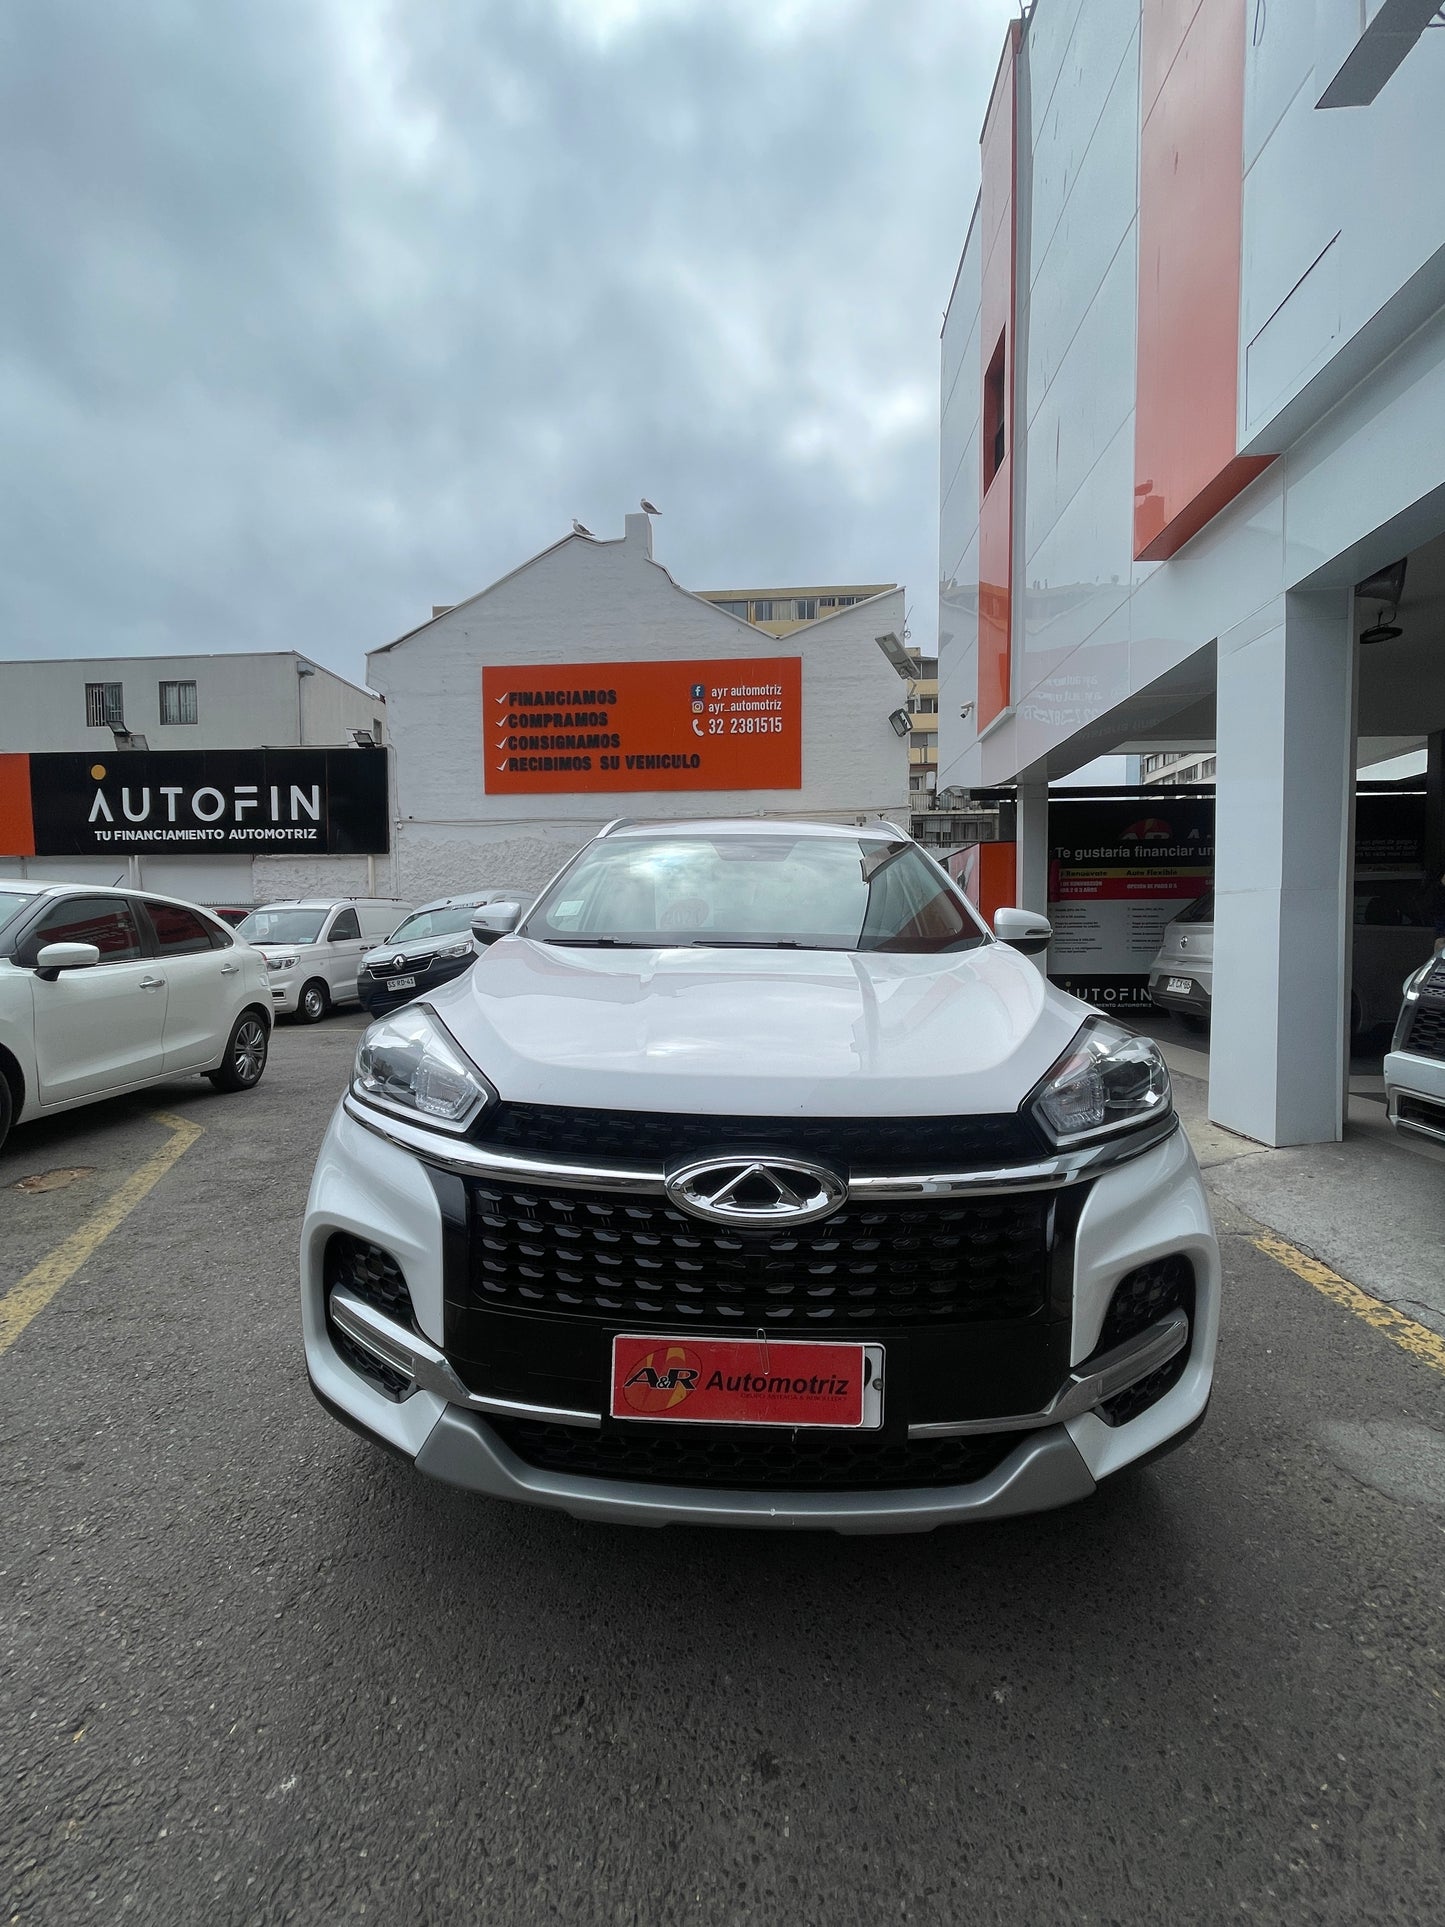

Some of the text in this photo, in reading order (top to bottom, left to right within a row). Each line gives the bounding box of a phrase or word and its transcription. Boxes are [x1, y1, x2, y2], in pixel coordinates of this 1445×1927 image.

[508, 690, 617, 707] FINANCIAMOS
[711, 684, 782, 698] ayr automotriz
[708, 699, 782, 713] ayr_automotriz
[508, 712, 608, 729] COMPRAMOS
[708, 717, 782, 735] 32 2381515
[508, 734, 621, 750] CONSIGNAMOS
[509, 754, 700, 772] RECIBIMOS SU VEHICULO
[88, 784, 320, 822] AUTOFIN
[94, 827, 318, 841] TU FINANCIAMIENTO AUTOMOTRIZ
[1055, 847, 1070, 858] Te
[1075, 845, 1131, 861] gustaría
[1135, 845, 1193, 858] financiar
[1066, 987, 1152, 1001] UTOFIN
[624, 1367, 849, 1396] A&R Automotriz
